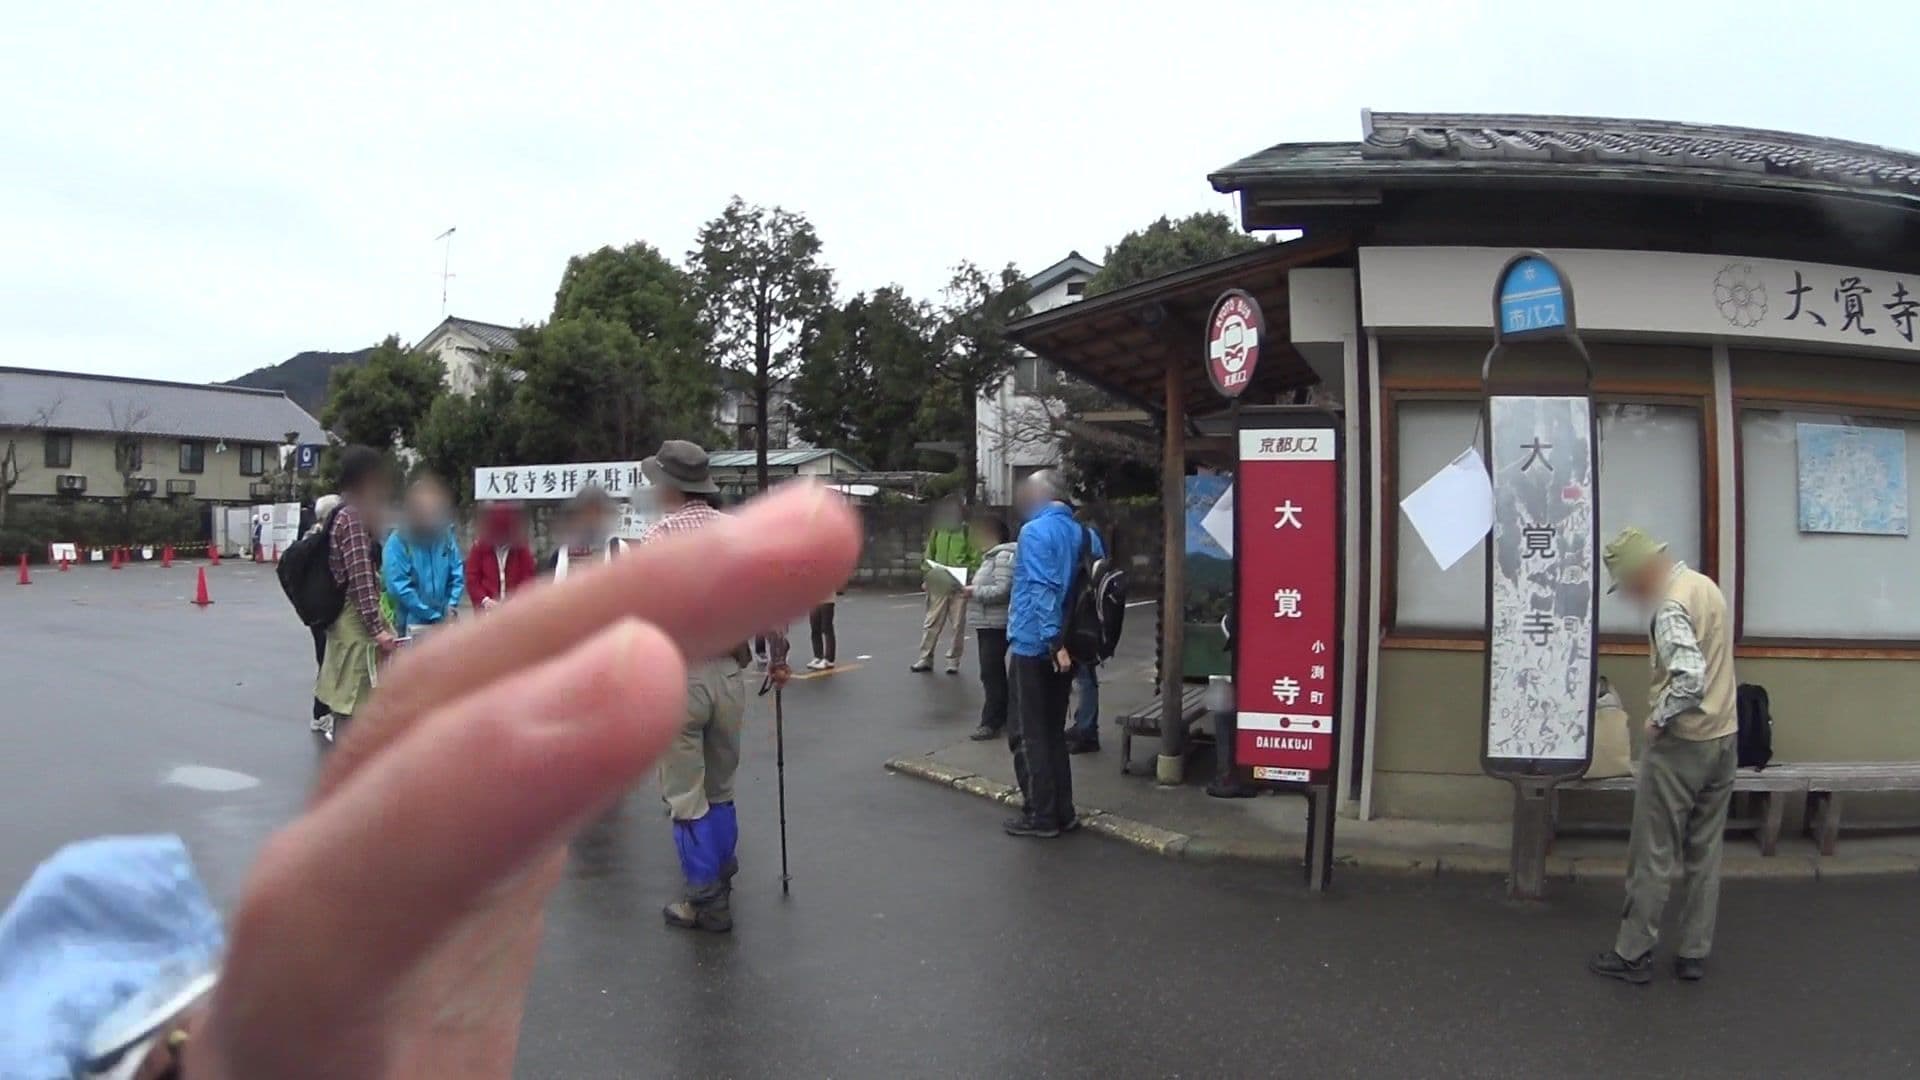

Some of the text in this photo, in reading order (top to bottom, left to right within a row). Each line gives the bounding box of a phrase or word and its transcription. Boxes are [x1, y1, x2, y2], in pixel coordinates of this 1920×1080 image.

[1508, 303, 1561, 328] 市バス
[1783, 269, 1920, 342] 大覚寺
[1258, 437, 1318, 453] 京都バス
[1519, 436, 1555, 647] 大覚寺
[1272, 499, 1303, 706] 大覚寺
[1256, 735, 1313, 751] DAIKAKUJI
